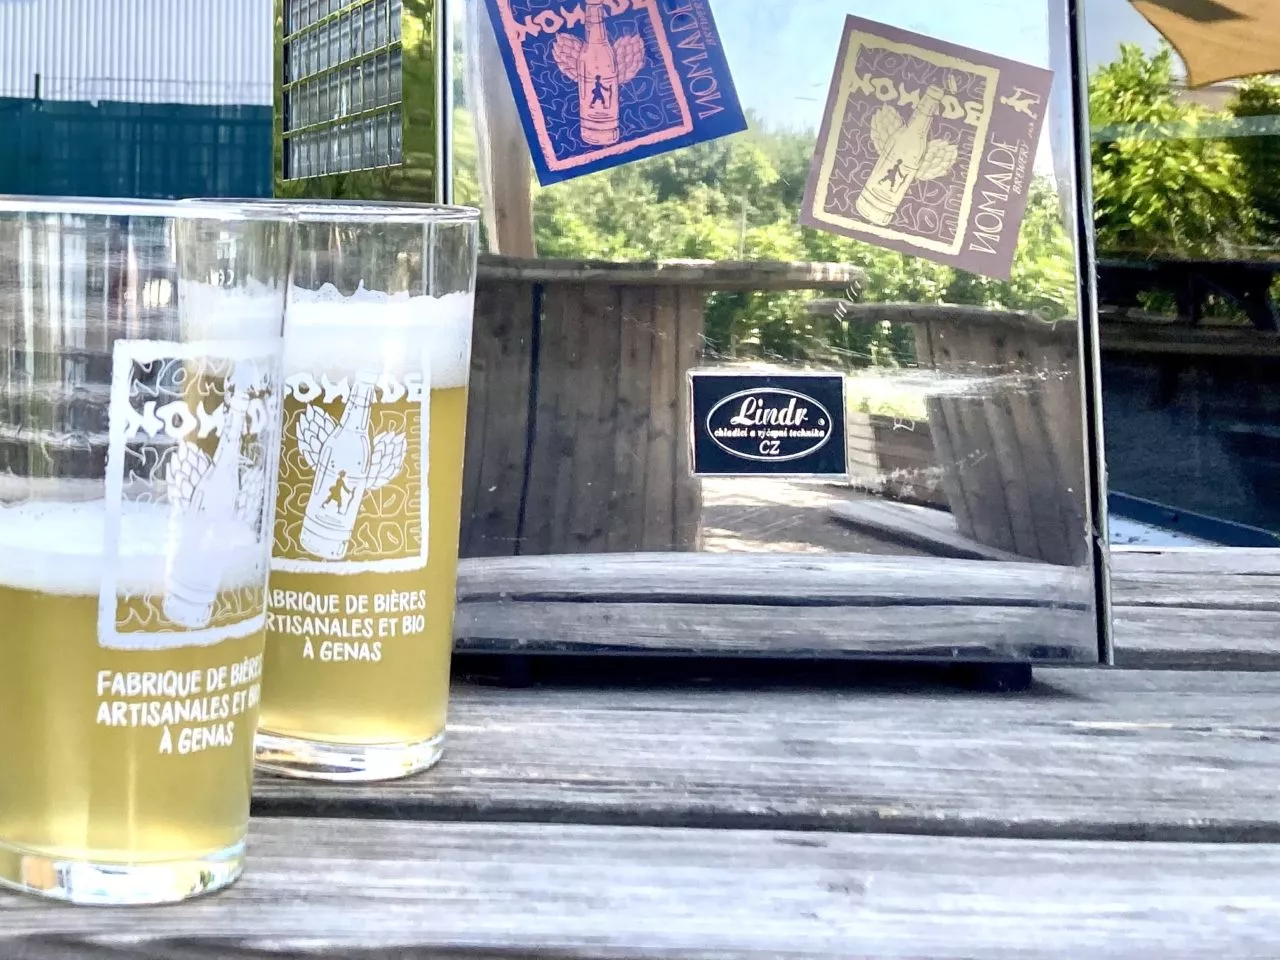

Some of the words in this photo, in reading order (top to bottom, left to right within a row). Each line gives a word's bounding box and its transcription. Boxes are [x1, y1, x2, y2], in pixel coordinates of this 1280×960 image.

[663, 2, 725, 120] NOMADE
[849, 73, 985, 127] NOMDE
[969, 132, 1020, 254] NOMADE
[730, 396, 808, 426] Lindr
[759, 440, 781, 455] CZ
[344, 594, 368, 615] DE
[373, 589, 426, 613] BIÈRES
[266, 611, 374, 638] RTISANALES
[378, 616, 398, 638] ET
[402, 614, 425, 635] BIO
[302, 636, 315, 661] À
[319, 640, 382, 662] GENAS
[96, 669, 202, 698] FABRIQUE
[206, 665, 228, 692] DE
[96, 693, 229, 727] ARTISANALES
[232, 689, 248, 716] ET
[158, 724, 173, 755] À
[177, 721, 235, 755] GENAS
